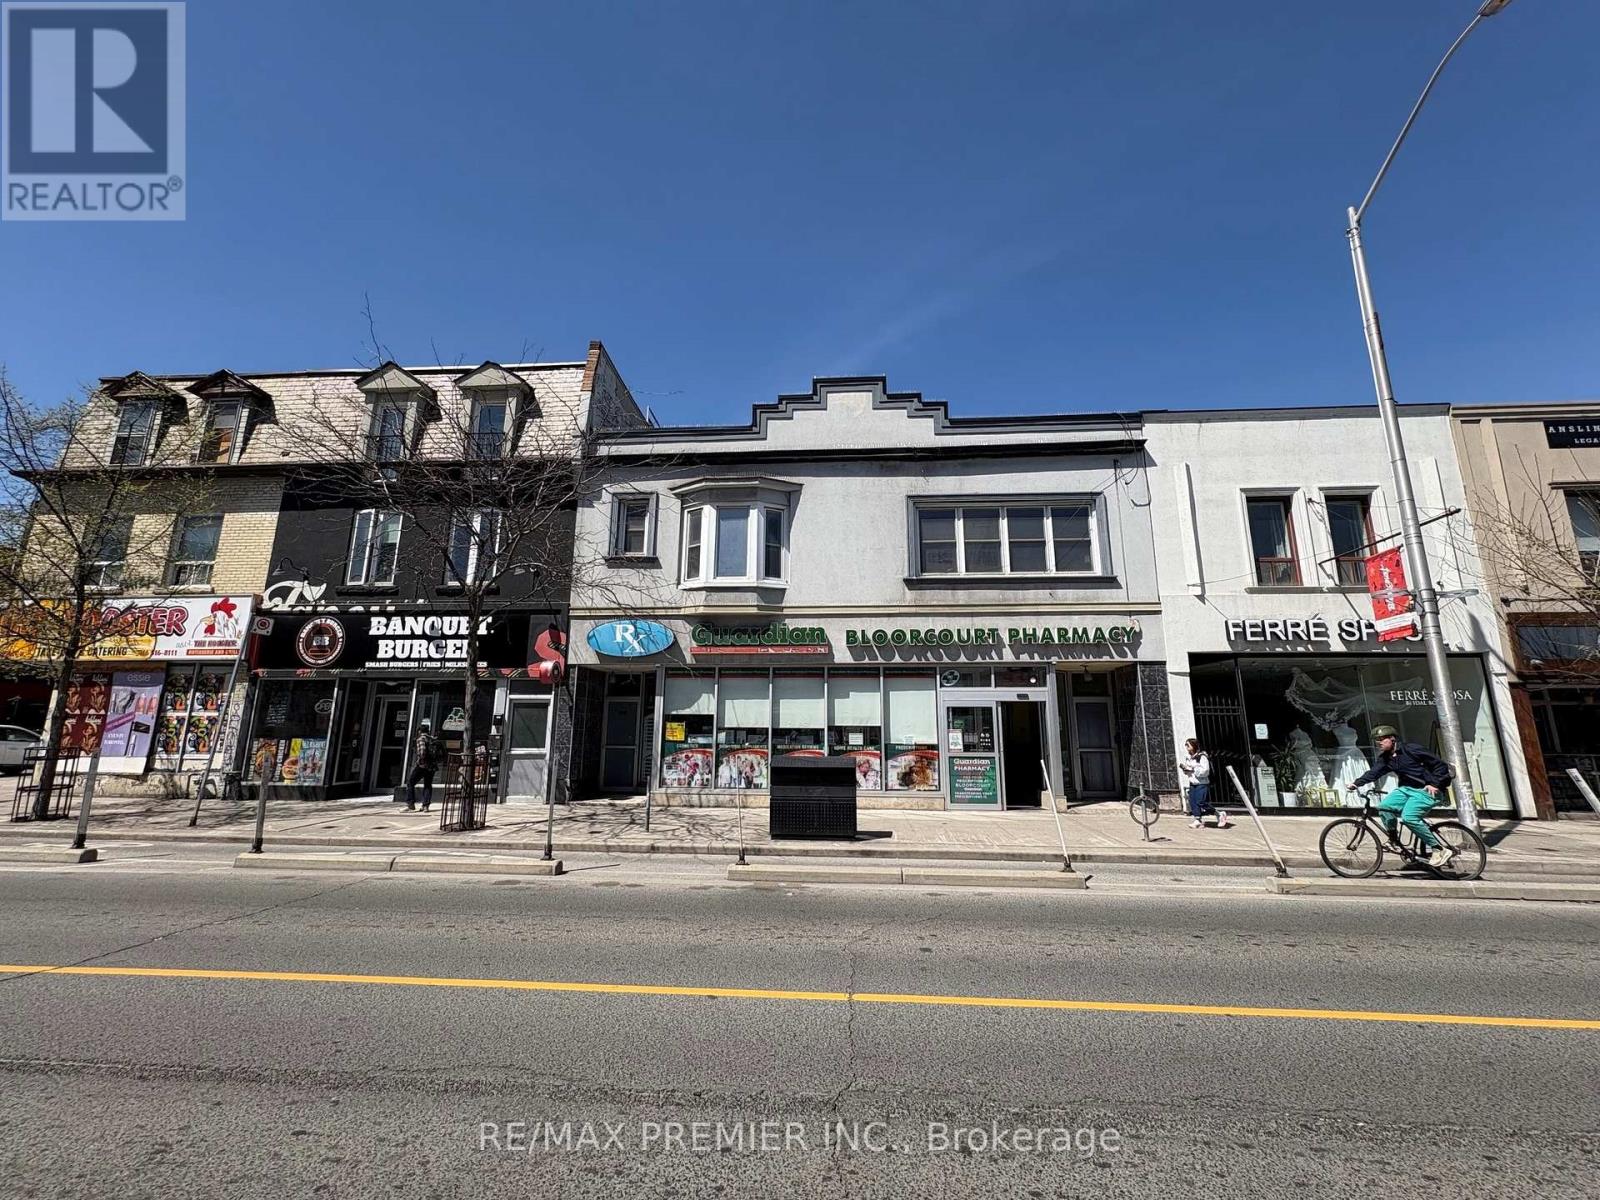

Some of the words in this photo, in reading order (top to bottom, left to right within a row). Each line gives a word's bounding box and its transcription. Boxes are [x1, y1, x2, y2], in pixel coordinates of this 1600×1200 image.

[691, 622, 828, 645] Guardian
[845, 628, 999, 646] BLOORCOURT
[1007, 626, 1136, 644] PHARMACY
[1228, 615, 1330, 641] FERRÉ
[1390, 688, 1429, 701] FERRÉ
